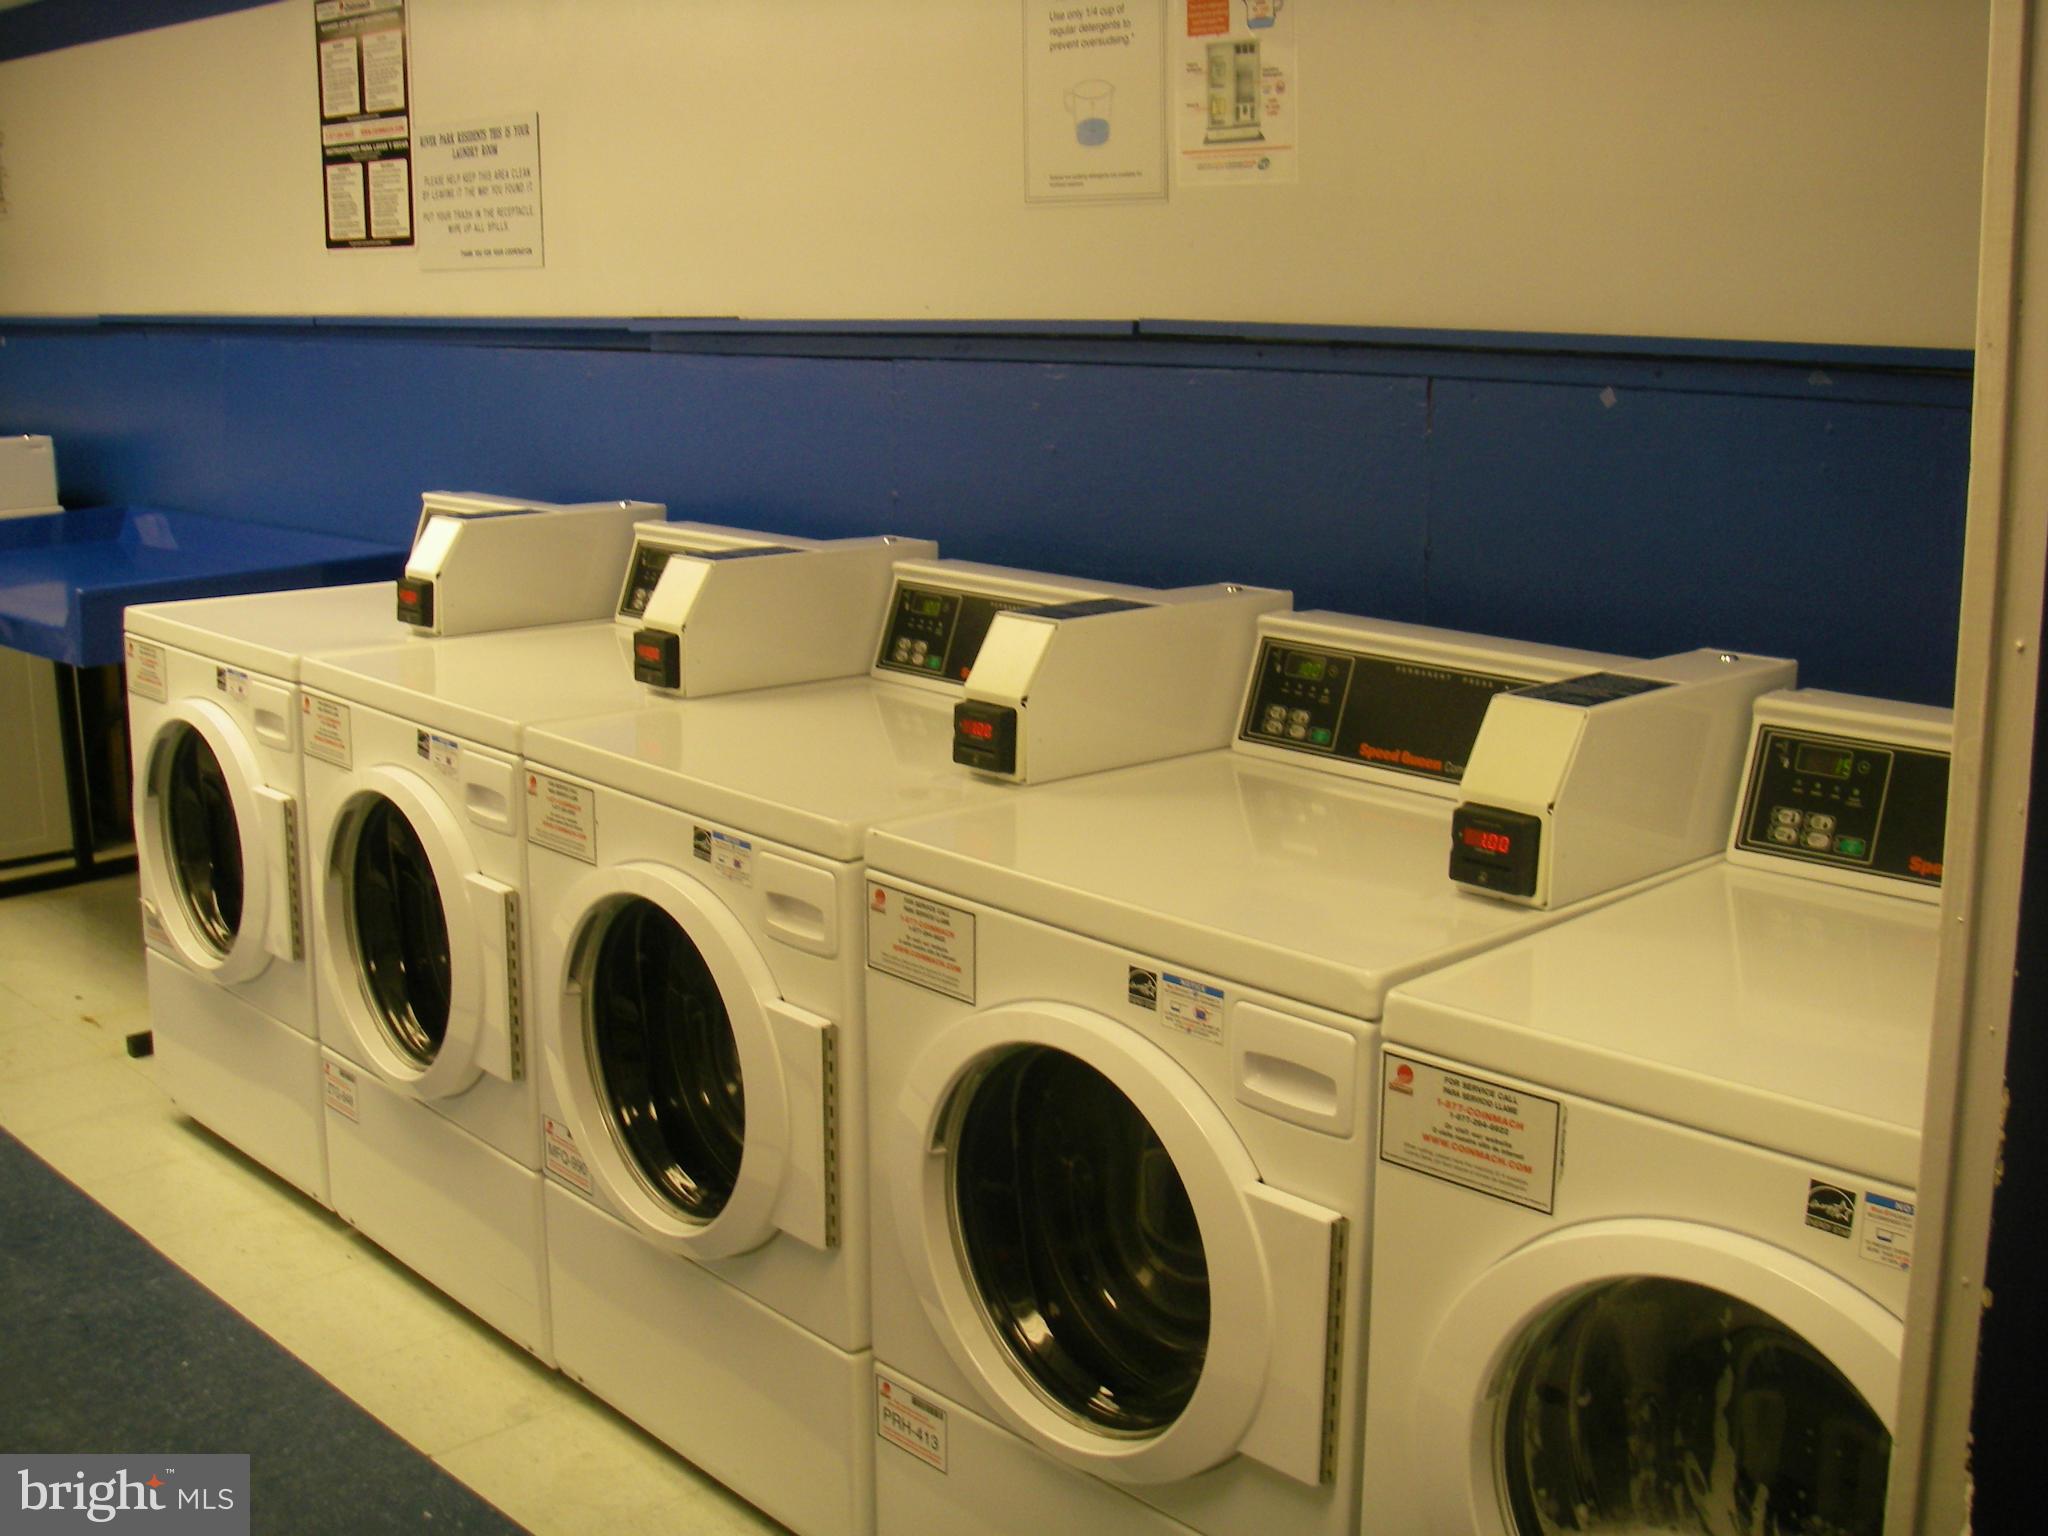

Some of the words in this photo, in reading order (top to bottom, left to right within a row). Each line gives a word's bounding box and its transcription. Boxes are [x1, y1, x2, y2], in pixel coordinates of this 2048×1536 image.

[1067, 8, 1082, 21] only
[1049, 24, 1075, 38] regular
[1079, 20, 1120, 34] detergents
[1123, 18, 1131, 28] to
[1049, 39, 1079, 53] prevent
[439, 132, 455, 145] PARK
[457, 128, 487, 143] RESIDENTS
[489, 126, 502, 139] THIS
[505, 126, 511, 138] IS
[513, 123, 530, 136] YOUR
[494, 168, 509, 180] AREA
[511, 167, 531, 179] CLEAN
[1444, 1076, 1460, 1086] FOR
[1462, 1081, 1496, 1097] SERVICE
[1497, 1091, 1518, 1105] CALL
[1437, 1097, 1524, 1130] 1-877-COINMACH
